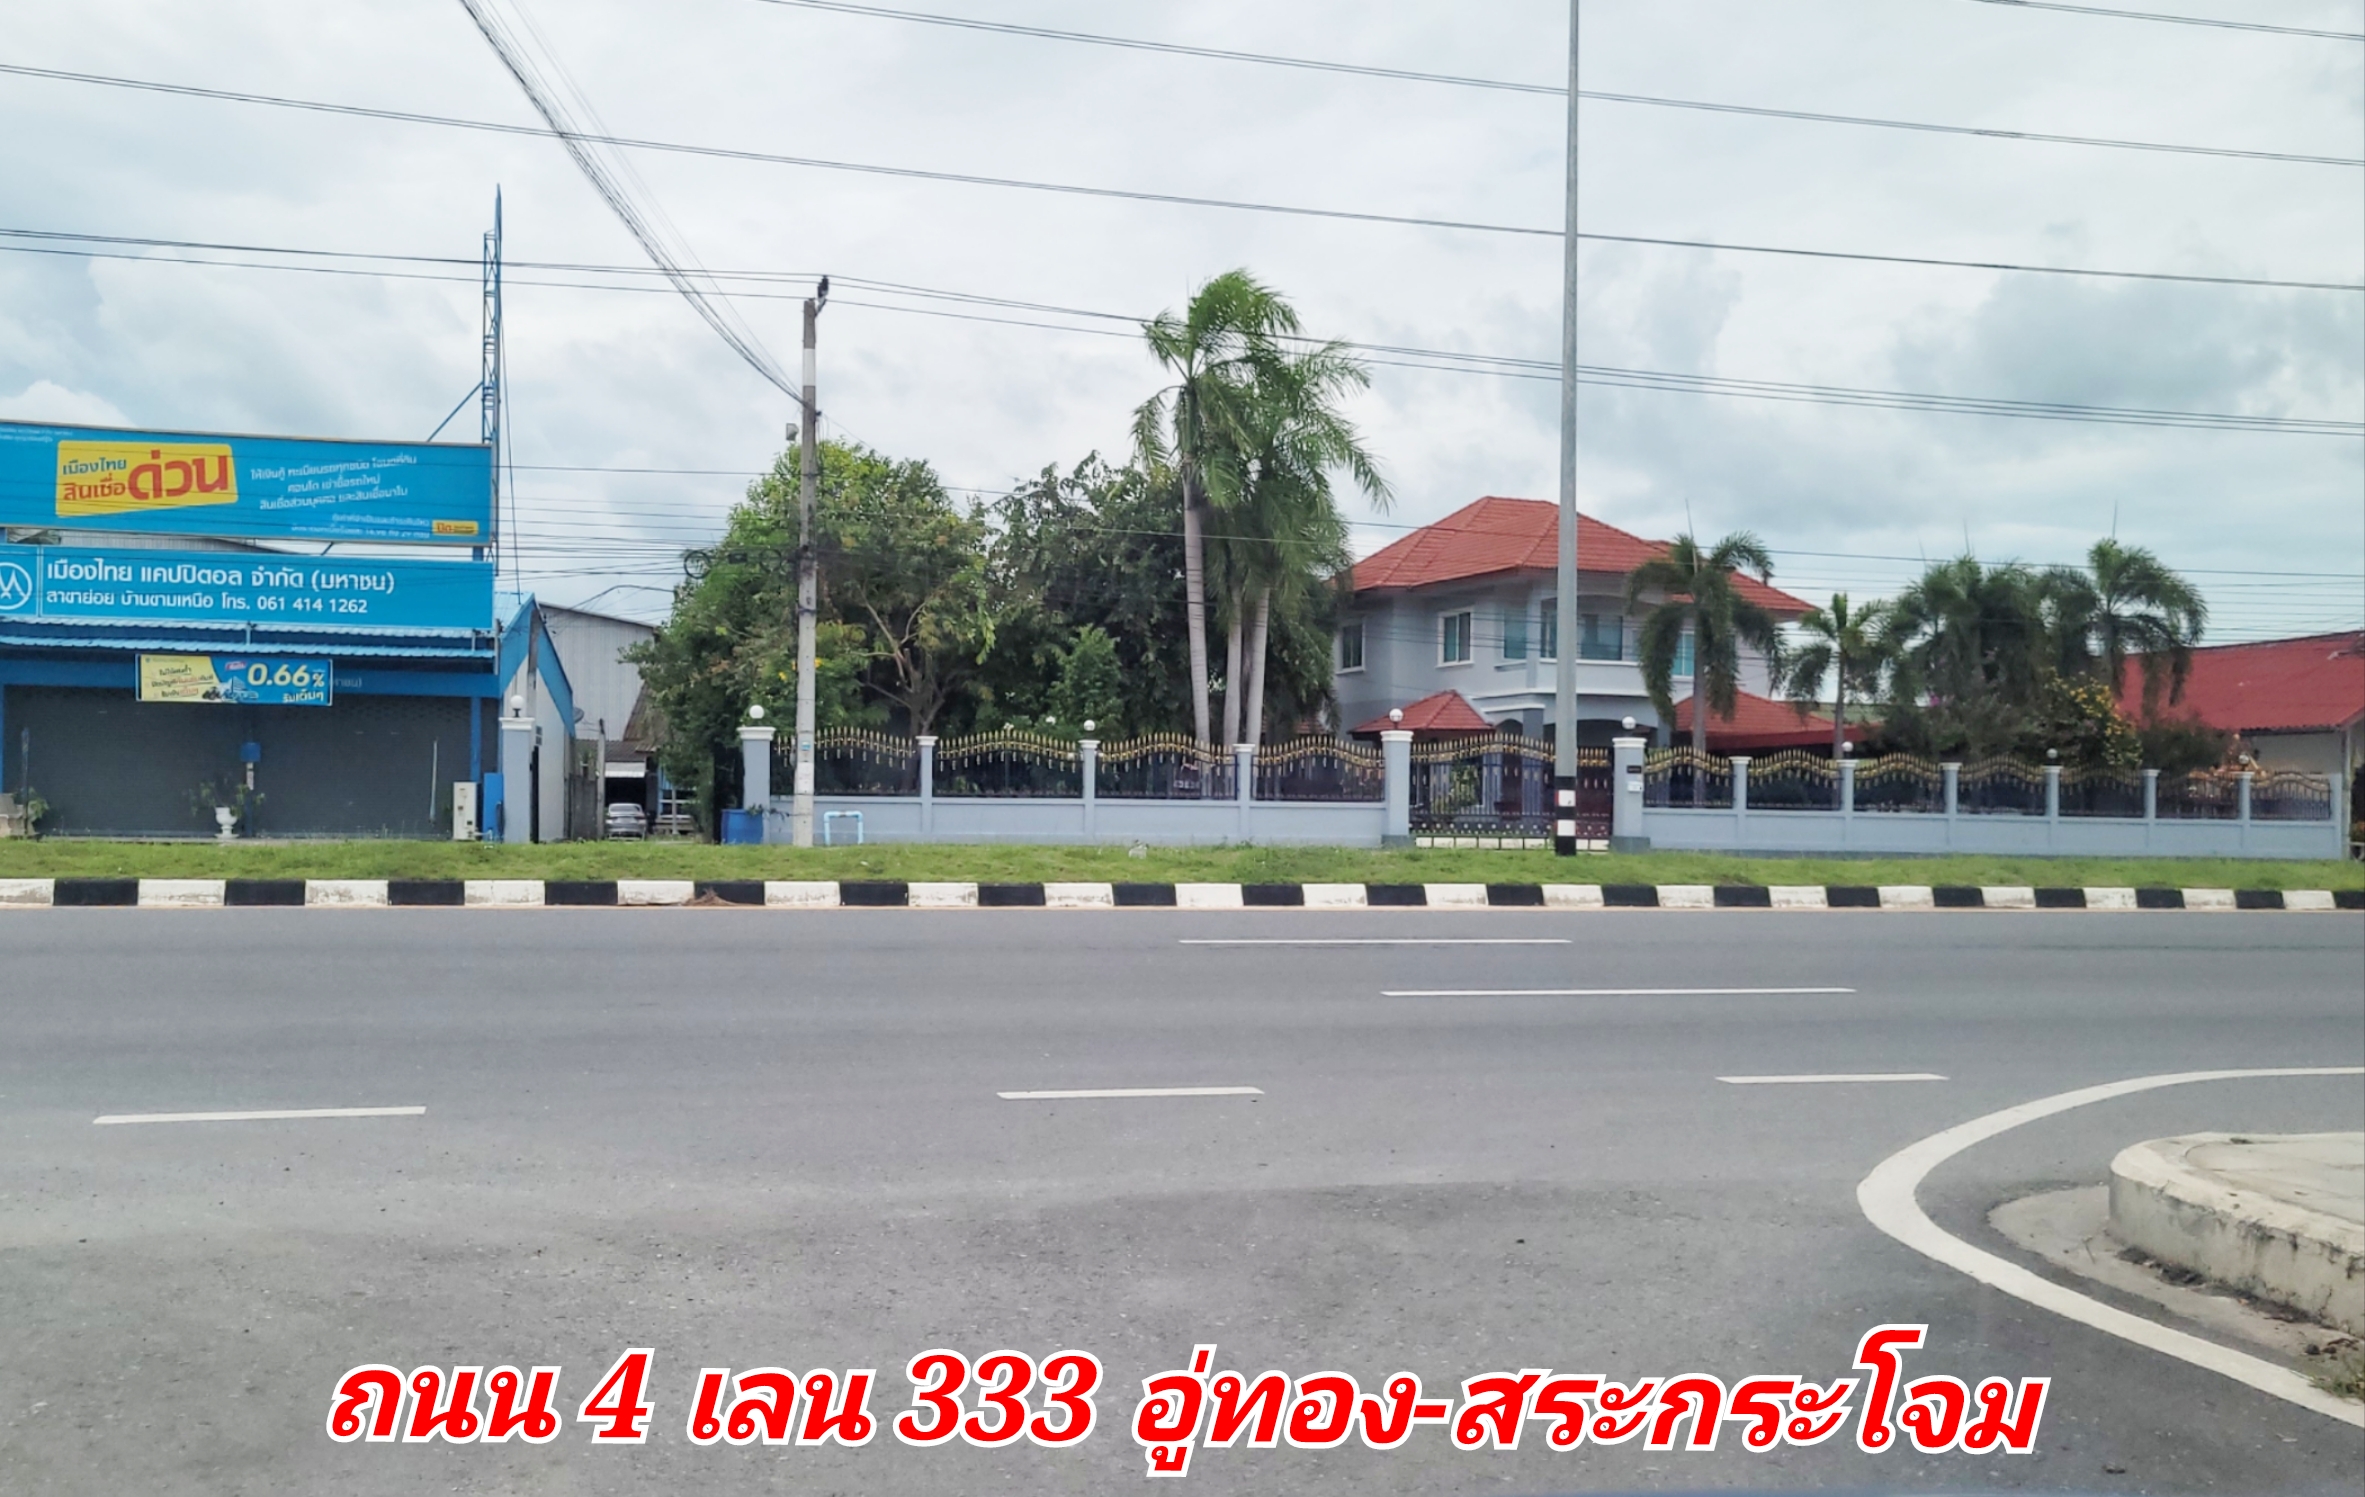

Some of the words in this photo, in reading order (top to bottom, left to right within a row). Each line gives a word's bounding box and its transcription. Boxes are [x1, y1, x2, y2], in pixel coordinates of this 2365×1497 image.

[62, 457, 127, 475] เมืองไทย
[127, 449, 229, 501] ด่วน
[63, 473, 126, 500] สินเชื่อ
[47, 557, 133, 581] เมืองไทย
[140, 564, 243, 586] แคปปิตอล
[251, 565, 304, 588] จำกัด
[311, 569, 395, 594] (มหาชน)
[46, 589, 115, 605] สาขาย่อย
[121, 590, 214, 609] บ้านขามเหนือ
[222, 592, 251, 610] โทร.
[257, 595, 285, 611] 061
[292, 598, 323, 612] 414
[329, 598, 368, 614] 1262
[247, 662, 325, 688] 0.66%
